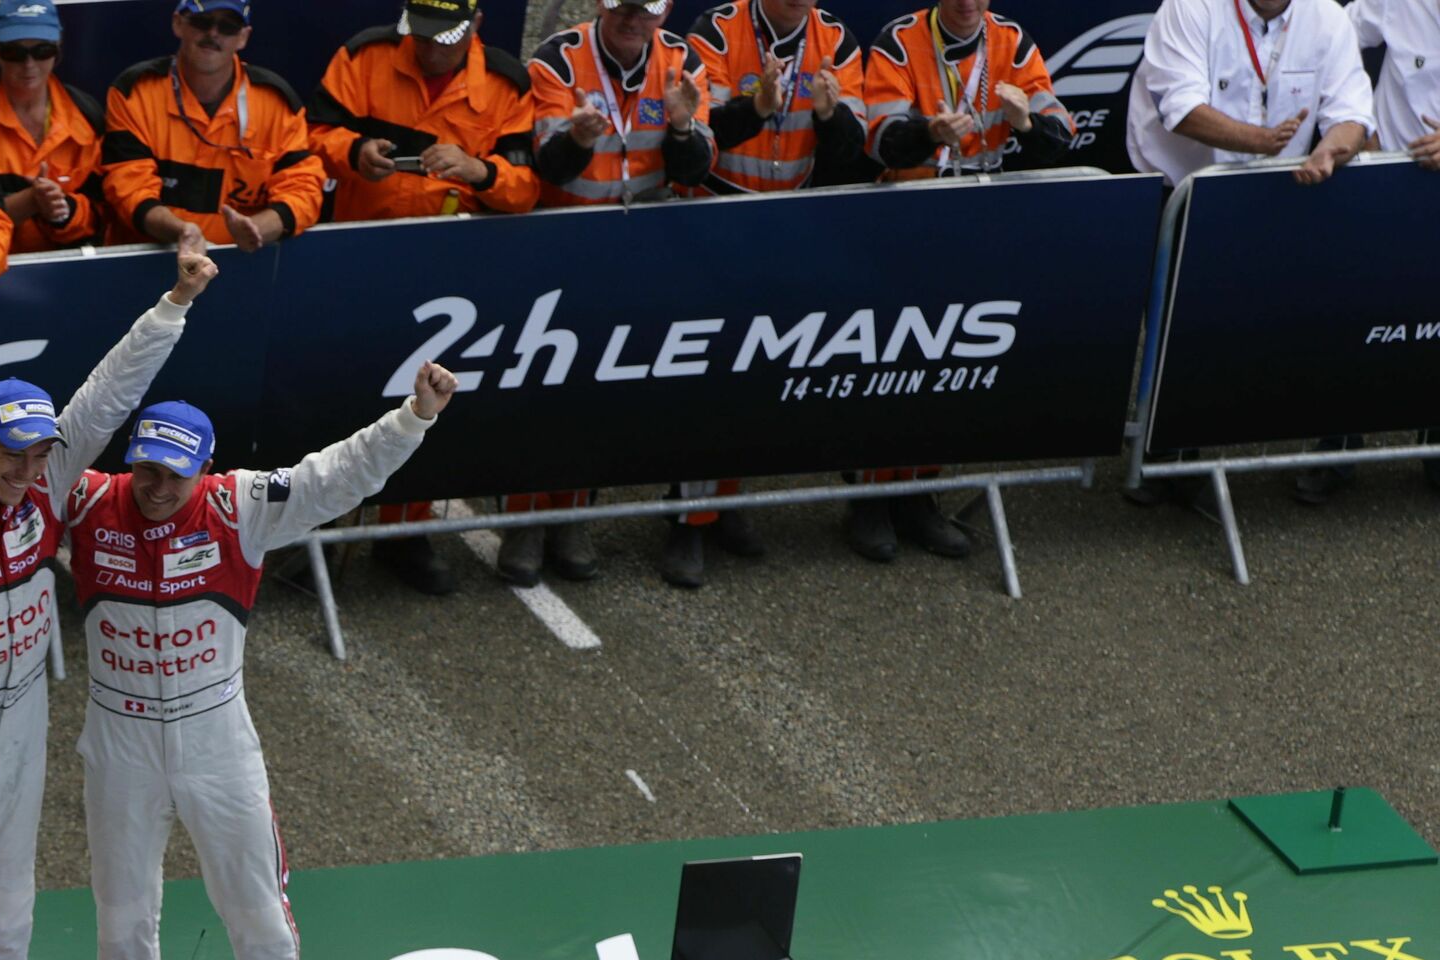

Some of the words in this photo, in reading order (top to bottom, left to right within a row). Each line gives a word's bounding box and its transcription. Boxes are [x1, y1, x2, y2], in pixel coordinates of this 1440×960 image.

[594, 318, 725, 382] LE
[731, 300, 1022, 373] MANS
[1365, 324, 1407, 344] FIA
[780, 373, 857, 402] 14-15
[862, 369, 926, 397] JUIN
[932, 364, 1000, 393] 2014
[95, 528, 136, 548] ORIS
[114, 574, 153, 592] Audi
[160, 575, 206, 595] Sport
[100, 619, 216, 651] e-tron
[101, 647, 216, 677] quattro
